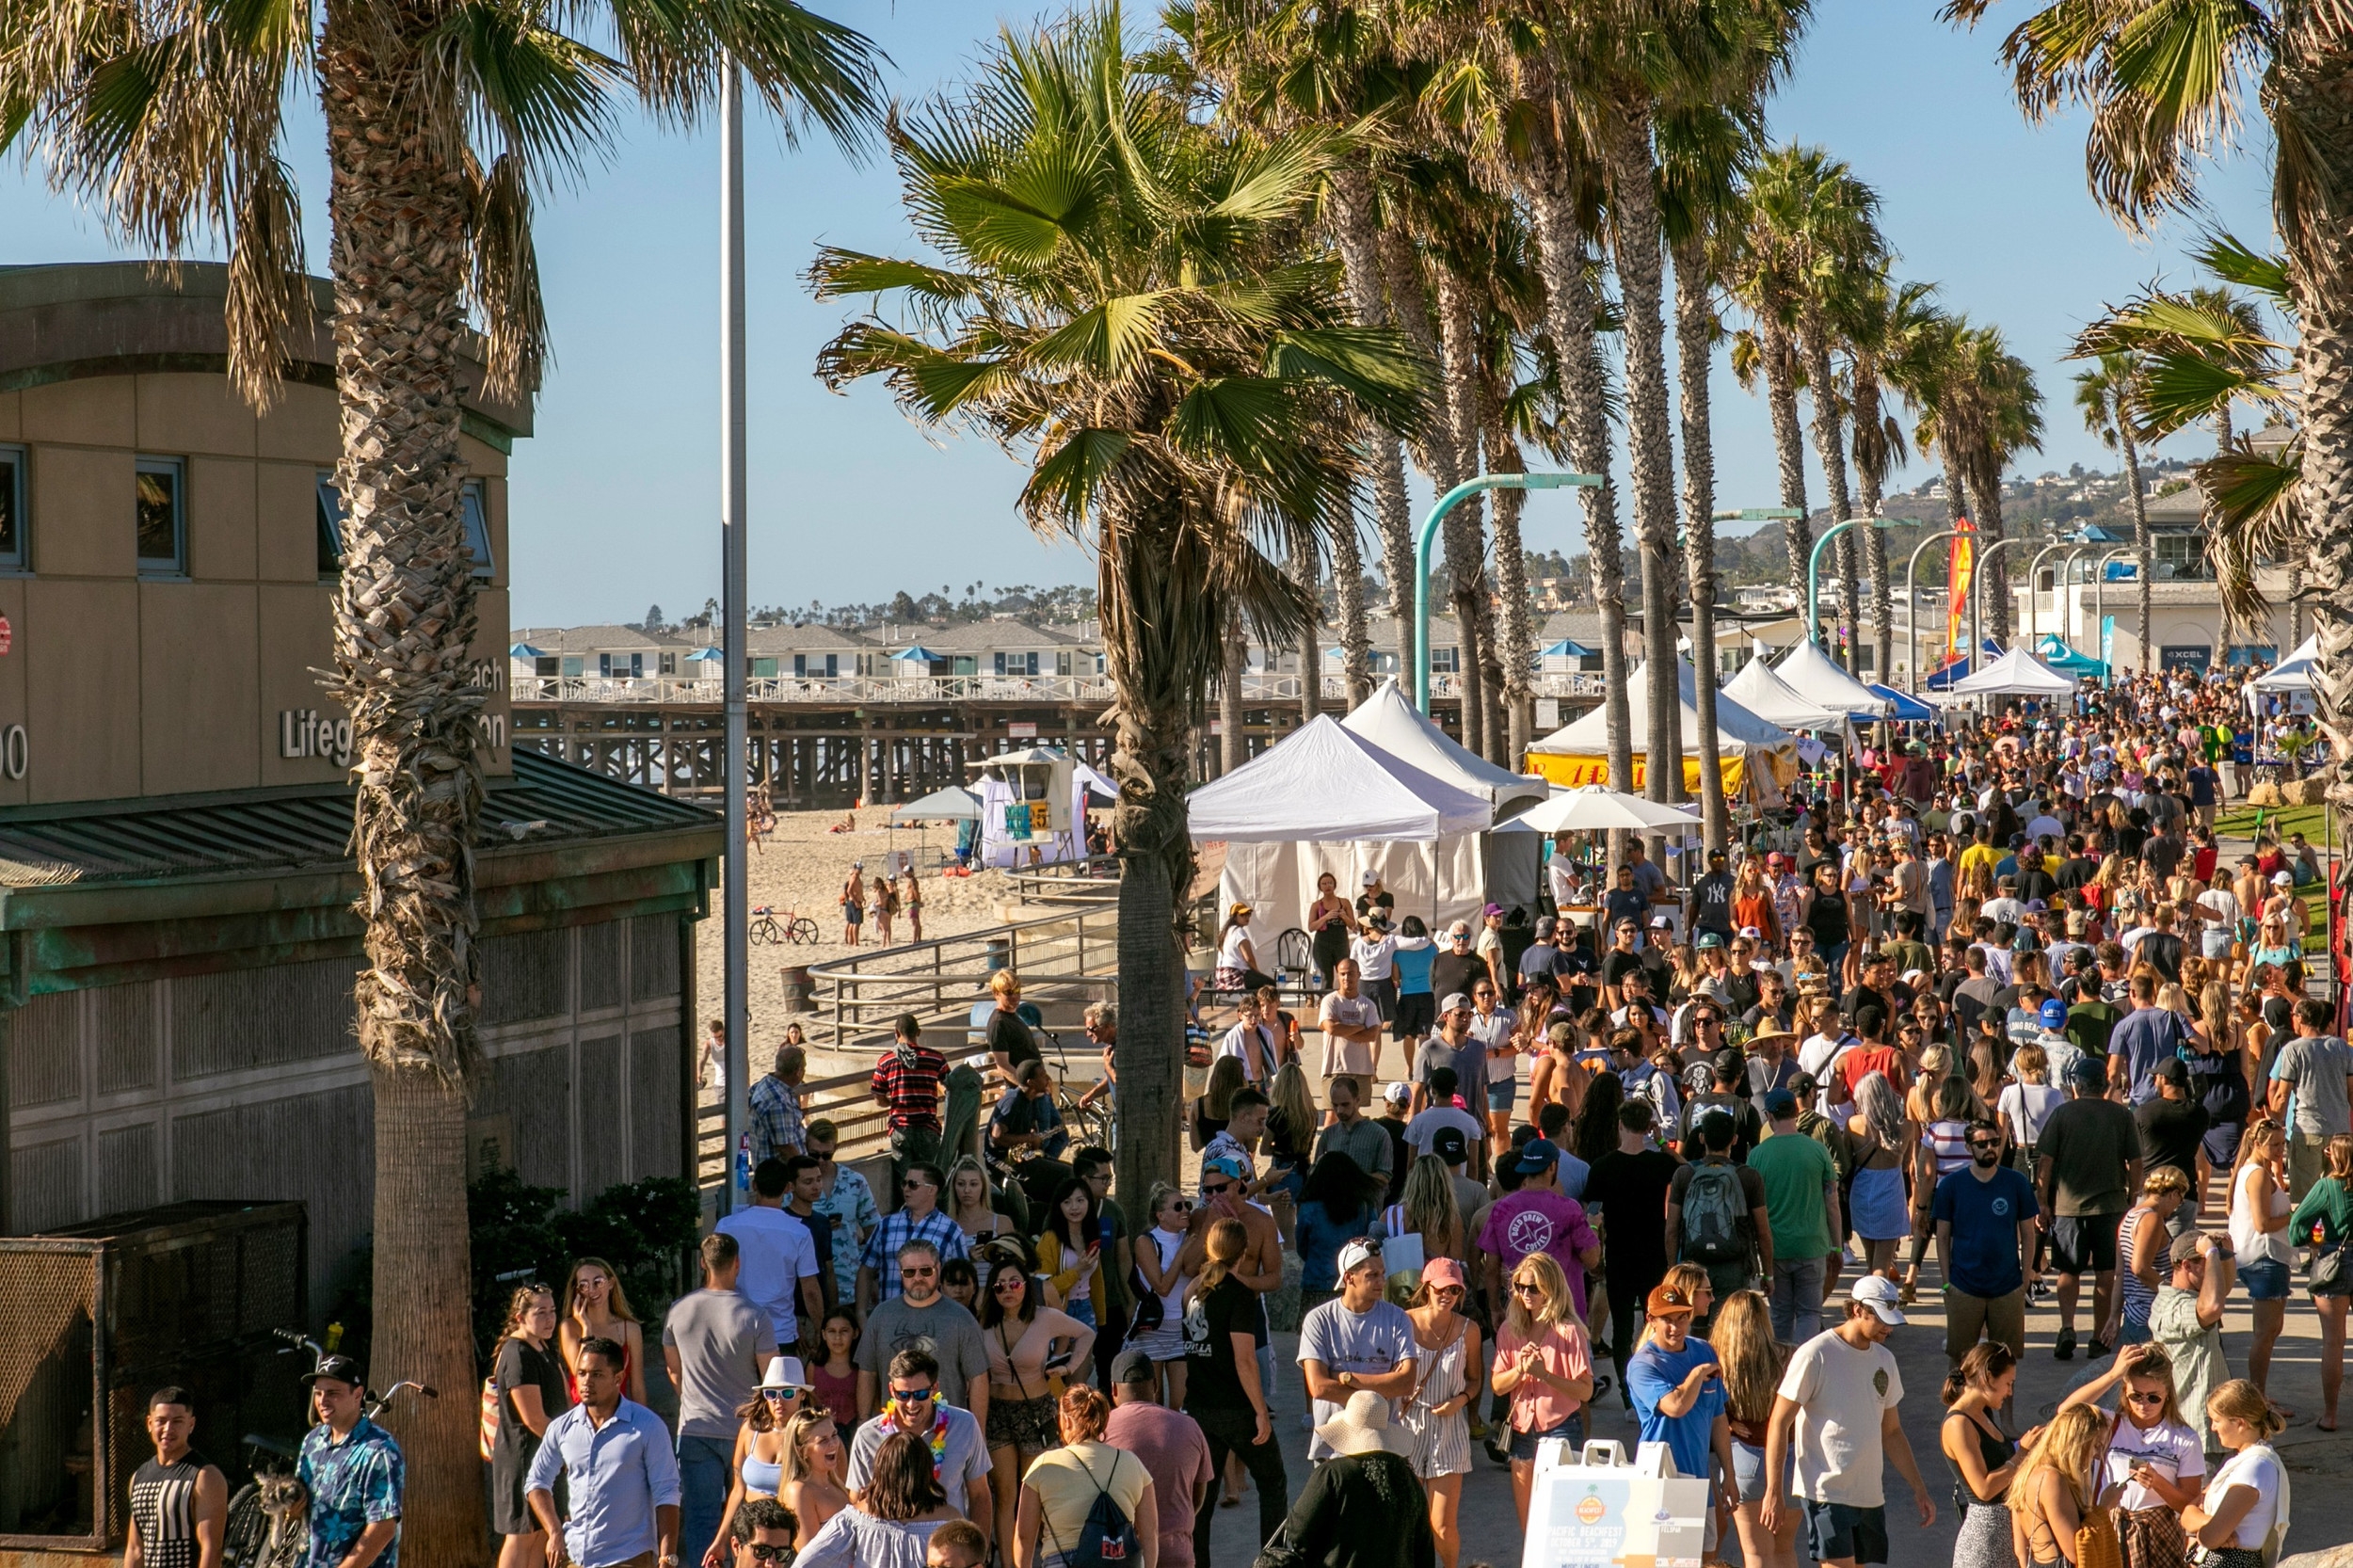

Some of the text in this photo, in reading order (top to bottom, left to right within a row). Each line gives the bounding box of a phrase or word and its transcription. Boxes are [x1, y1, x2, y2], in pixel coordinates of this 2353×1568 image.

[2175, 650, 2203, 659] XCEL
[1707, 882, 1726, 904] NY
[2009, 1021, 2024, 1032] LONG
[1512, 1213, 1543, 1237] BOLD BREW
[1525, 1233, 1547, 1251] COFFEE
[1547, 1526, 1623, 1537] PACIFIC BEACHFEST
[1550, 1537, 1581, 1547] OCTOBER
